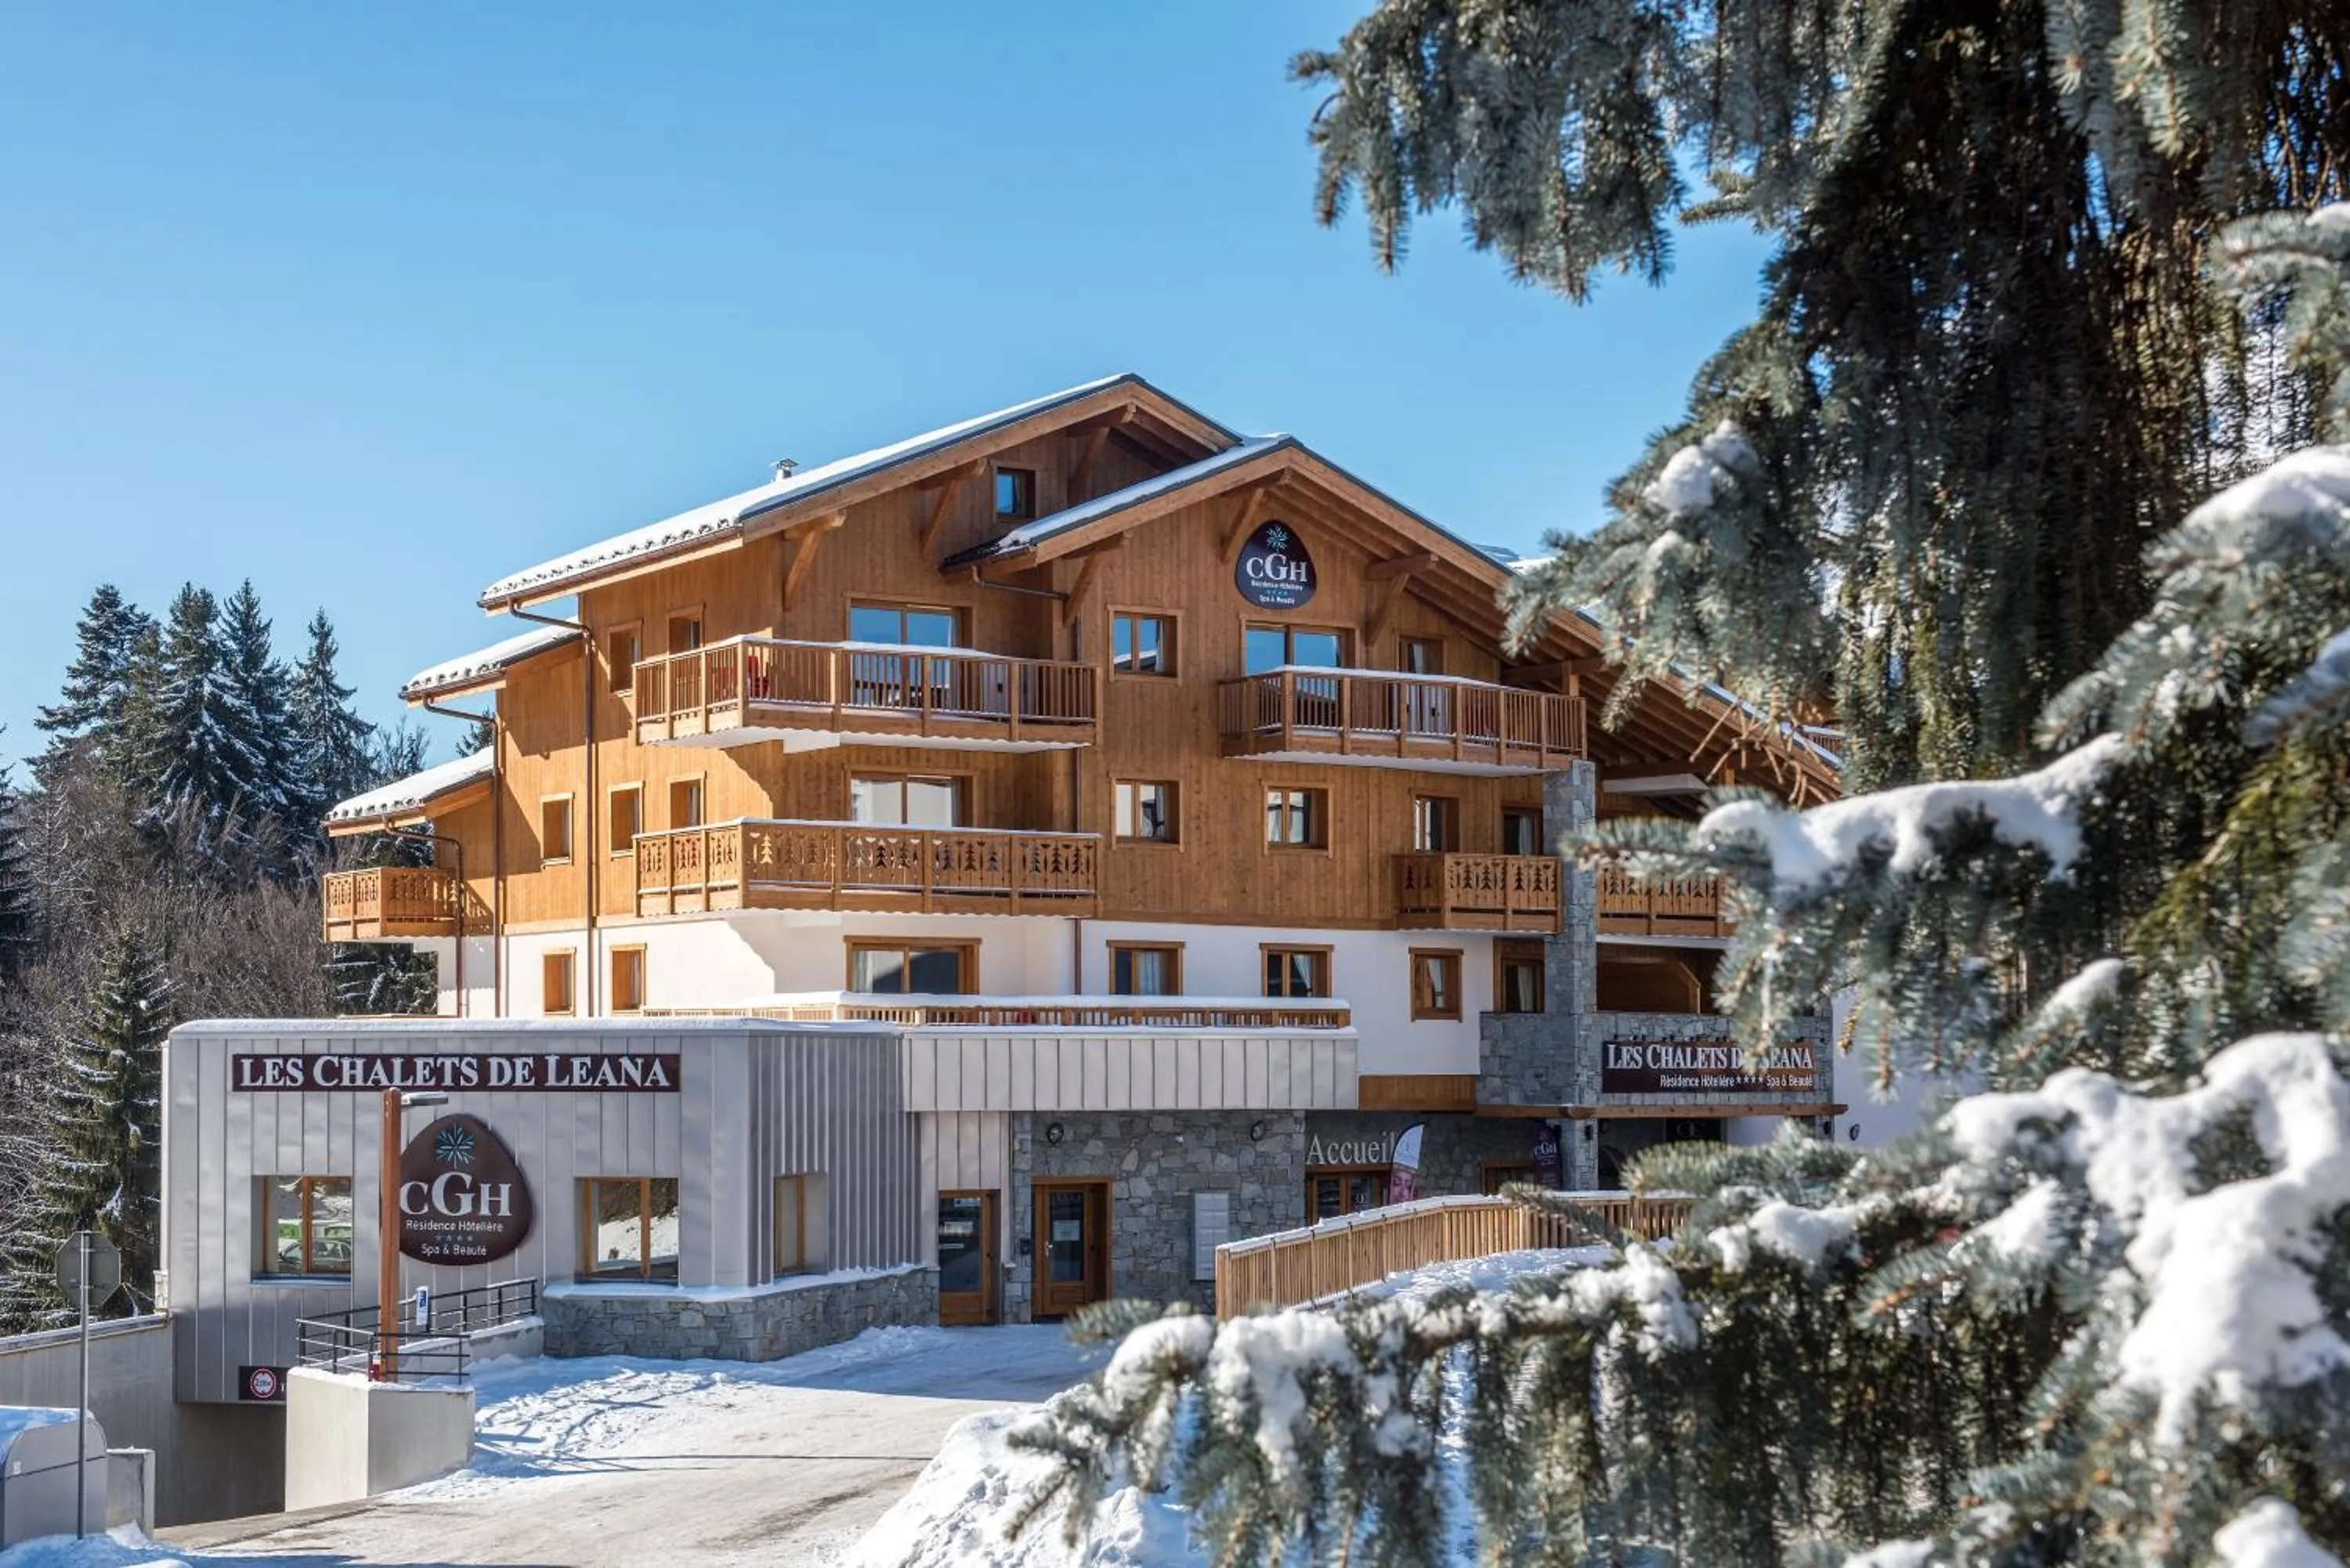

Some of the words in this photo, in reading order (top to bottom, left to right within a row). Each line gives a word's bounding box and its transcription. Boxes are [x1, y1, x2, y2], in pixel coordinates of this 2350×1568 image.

[1246, 553, 1307, 582] CGH
[1607, 1044, 1643, 1069] LES
[1646, 1044, 1728, 1069] CHALETS
[240, 1057, 305, 1087] LES
[313, 1055, 479, 1088] CHALETS
[486, 1057, 536, 1087] DE
[544, 1055, 671, 1088] LEANA
[1766, 1074, 1781, 1089] Spa
[1306, 1131, 1396, 1165] Accueil
[399, 1171, 513, 1216] CGH
[421, 1243, 440, 1257] Spa
[454, 1244, 487, 1255] Beauté
